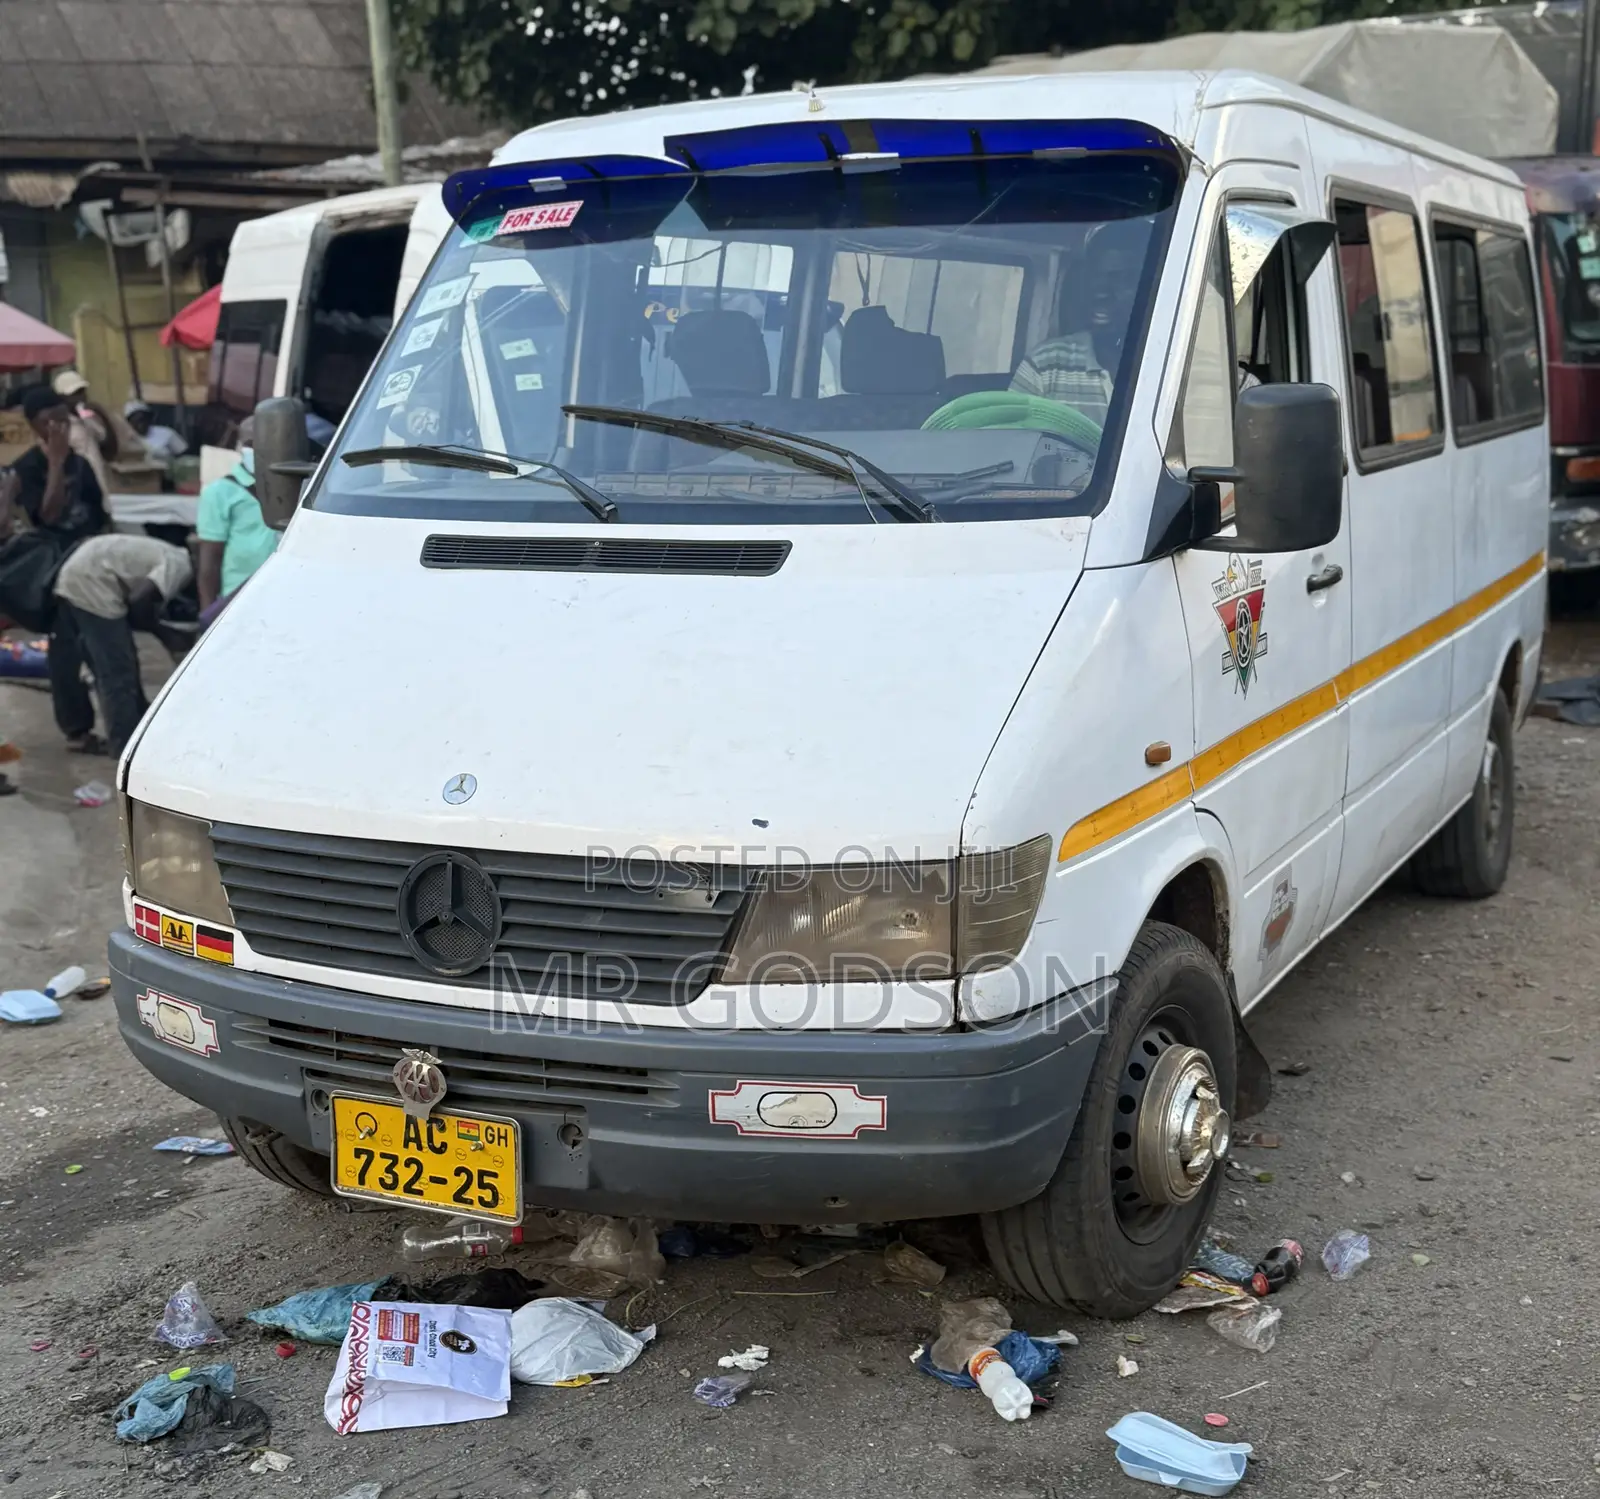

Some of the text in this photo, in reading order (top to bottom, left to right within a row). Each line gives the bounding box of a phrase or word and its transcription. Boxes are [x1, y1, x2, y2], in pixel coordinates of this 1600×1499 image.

[502, 211, 535, 230] FOR
[535, 206, 576, 224] SALE
[164, 921, 190, 942] AA
[403, 1113, 448, 1154] AC
[484, 1126, 508, 1148] GH
[353, 1147, 499, 1209] 732-25
